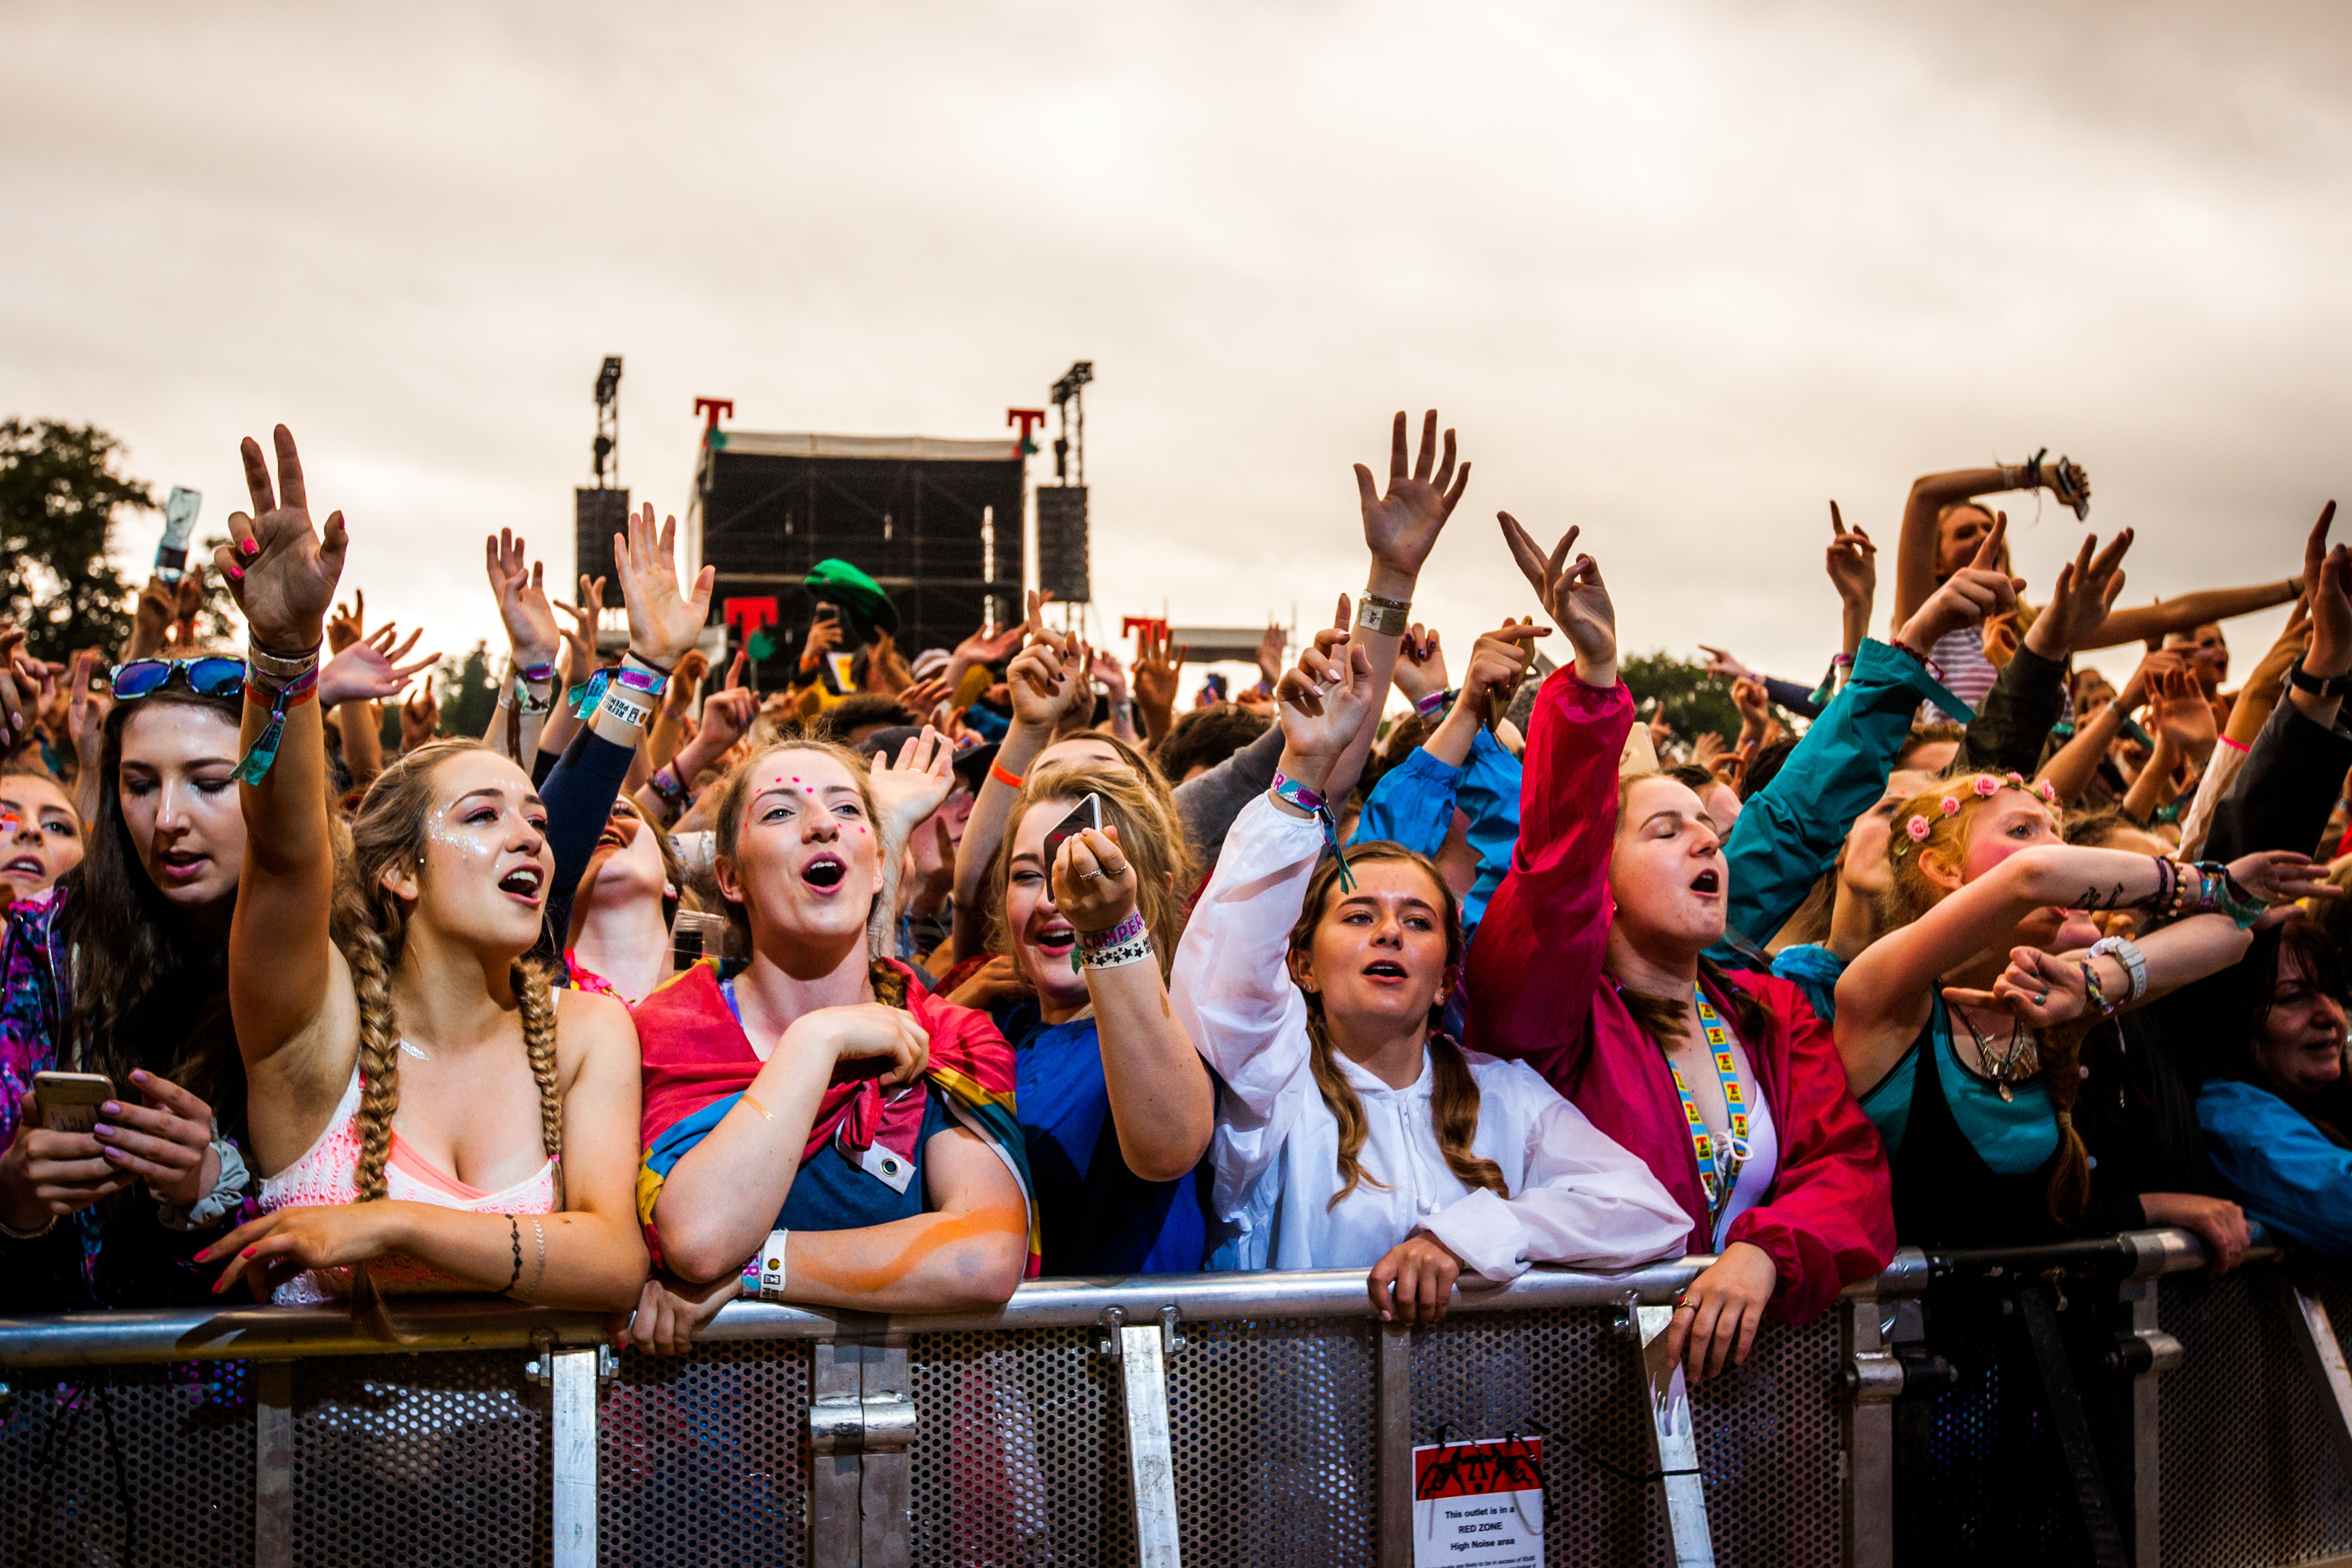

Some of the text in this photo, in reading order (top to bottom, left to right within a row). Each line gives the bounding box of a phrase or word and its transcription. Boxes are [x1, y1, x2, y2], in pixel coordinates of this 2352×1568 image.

[1082, 912, 1143, 949] CAMPER
[1464, 1508, 1487, 1517] outlet
[1458, 1522, 1502, 1533] RED ZONE
[1450, 1542, 1469, 1551] High
